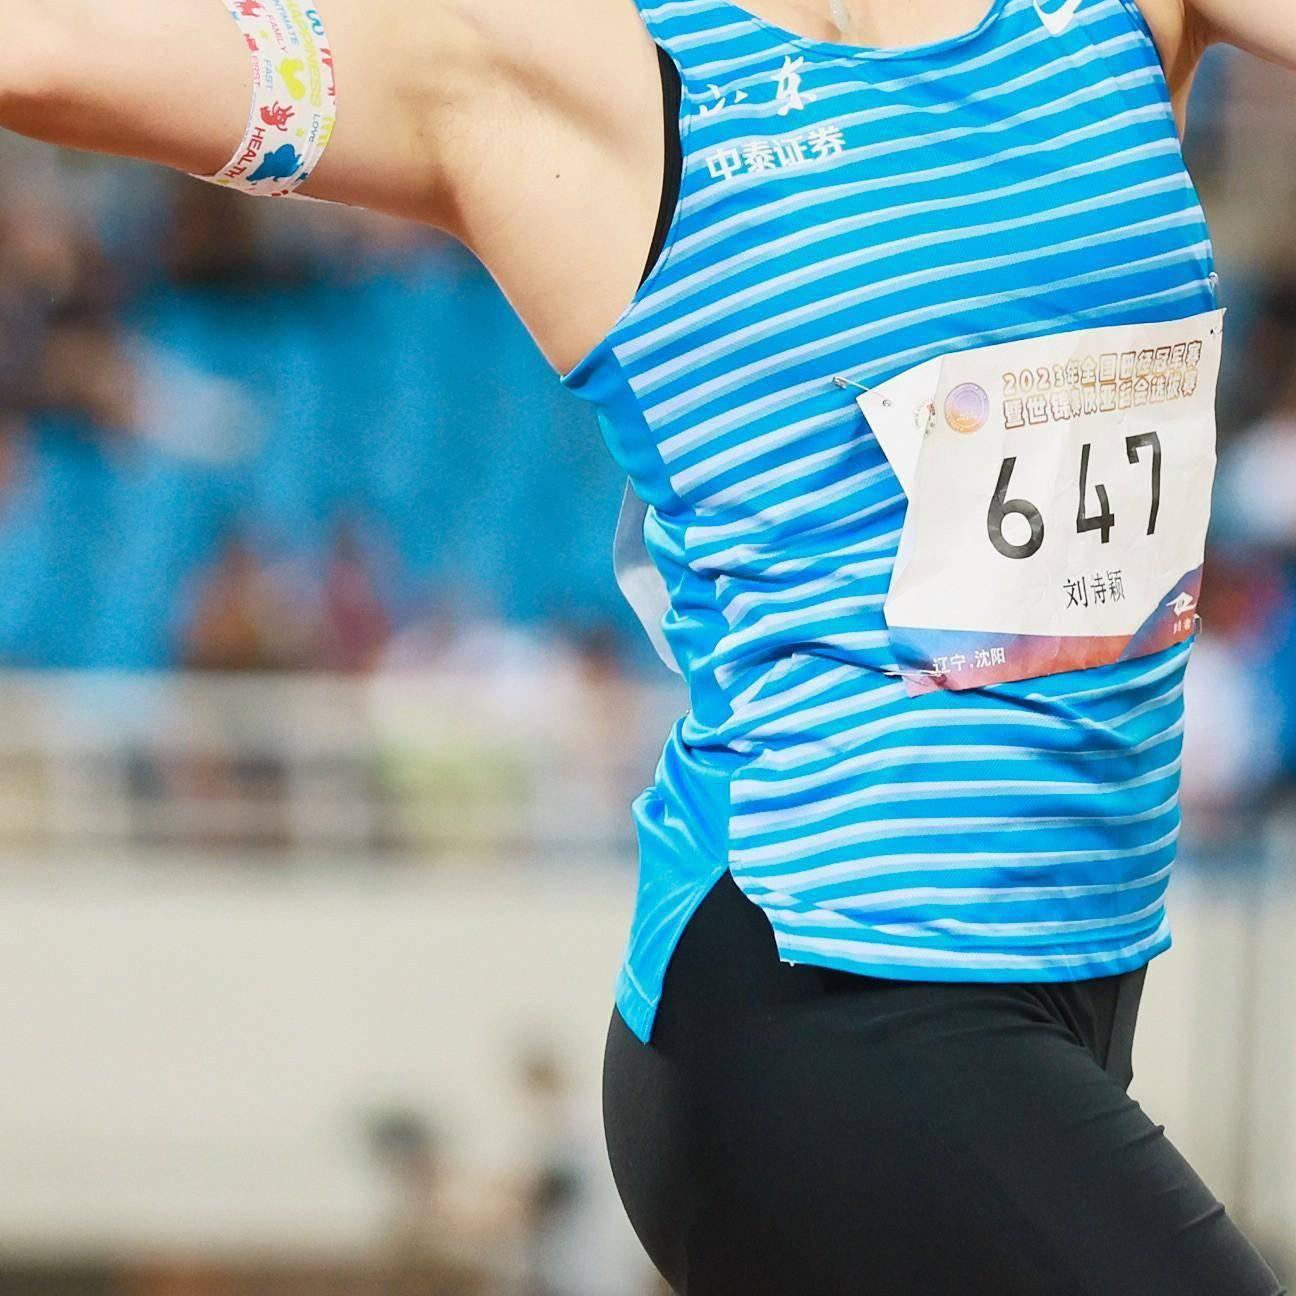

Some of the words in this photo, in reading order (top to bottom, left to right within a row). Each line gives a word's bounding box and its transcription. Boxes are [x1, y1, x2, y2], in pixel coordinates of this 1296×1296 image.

[264, 58, 275, 91] FAST
[224, 125, 266, 179] HEALTH
[705, 125, 847, 181] 中泰证券
[986, 430, 1162, 560] 647
